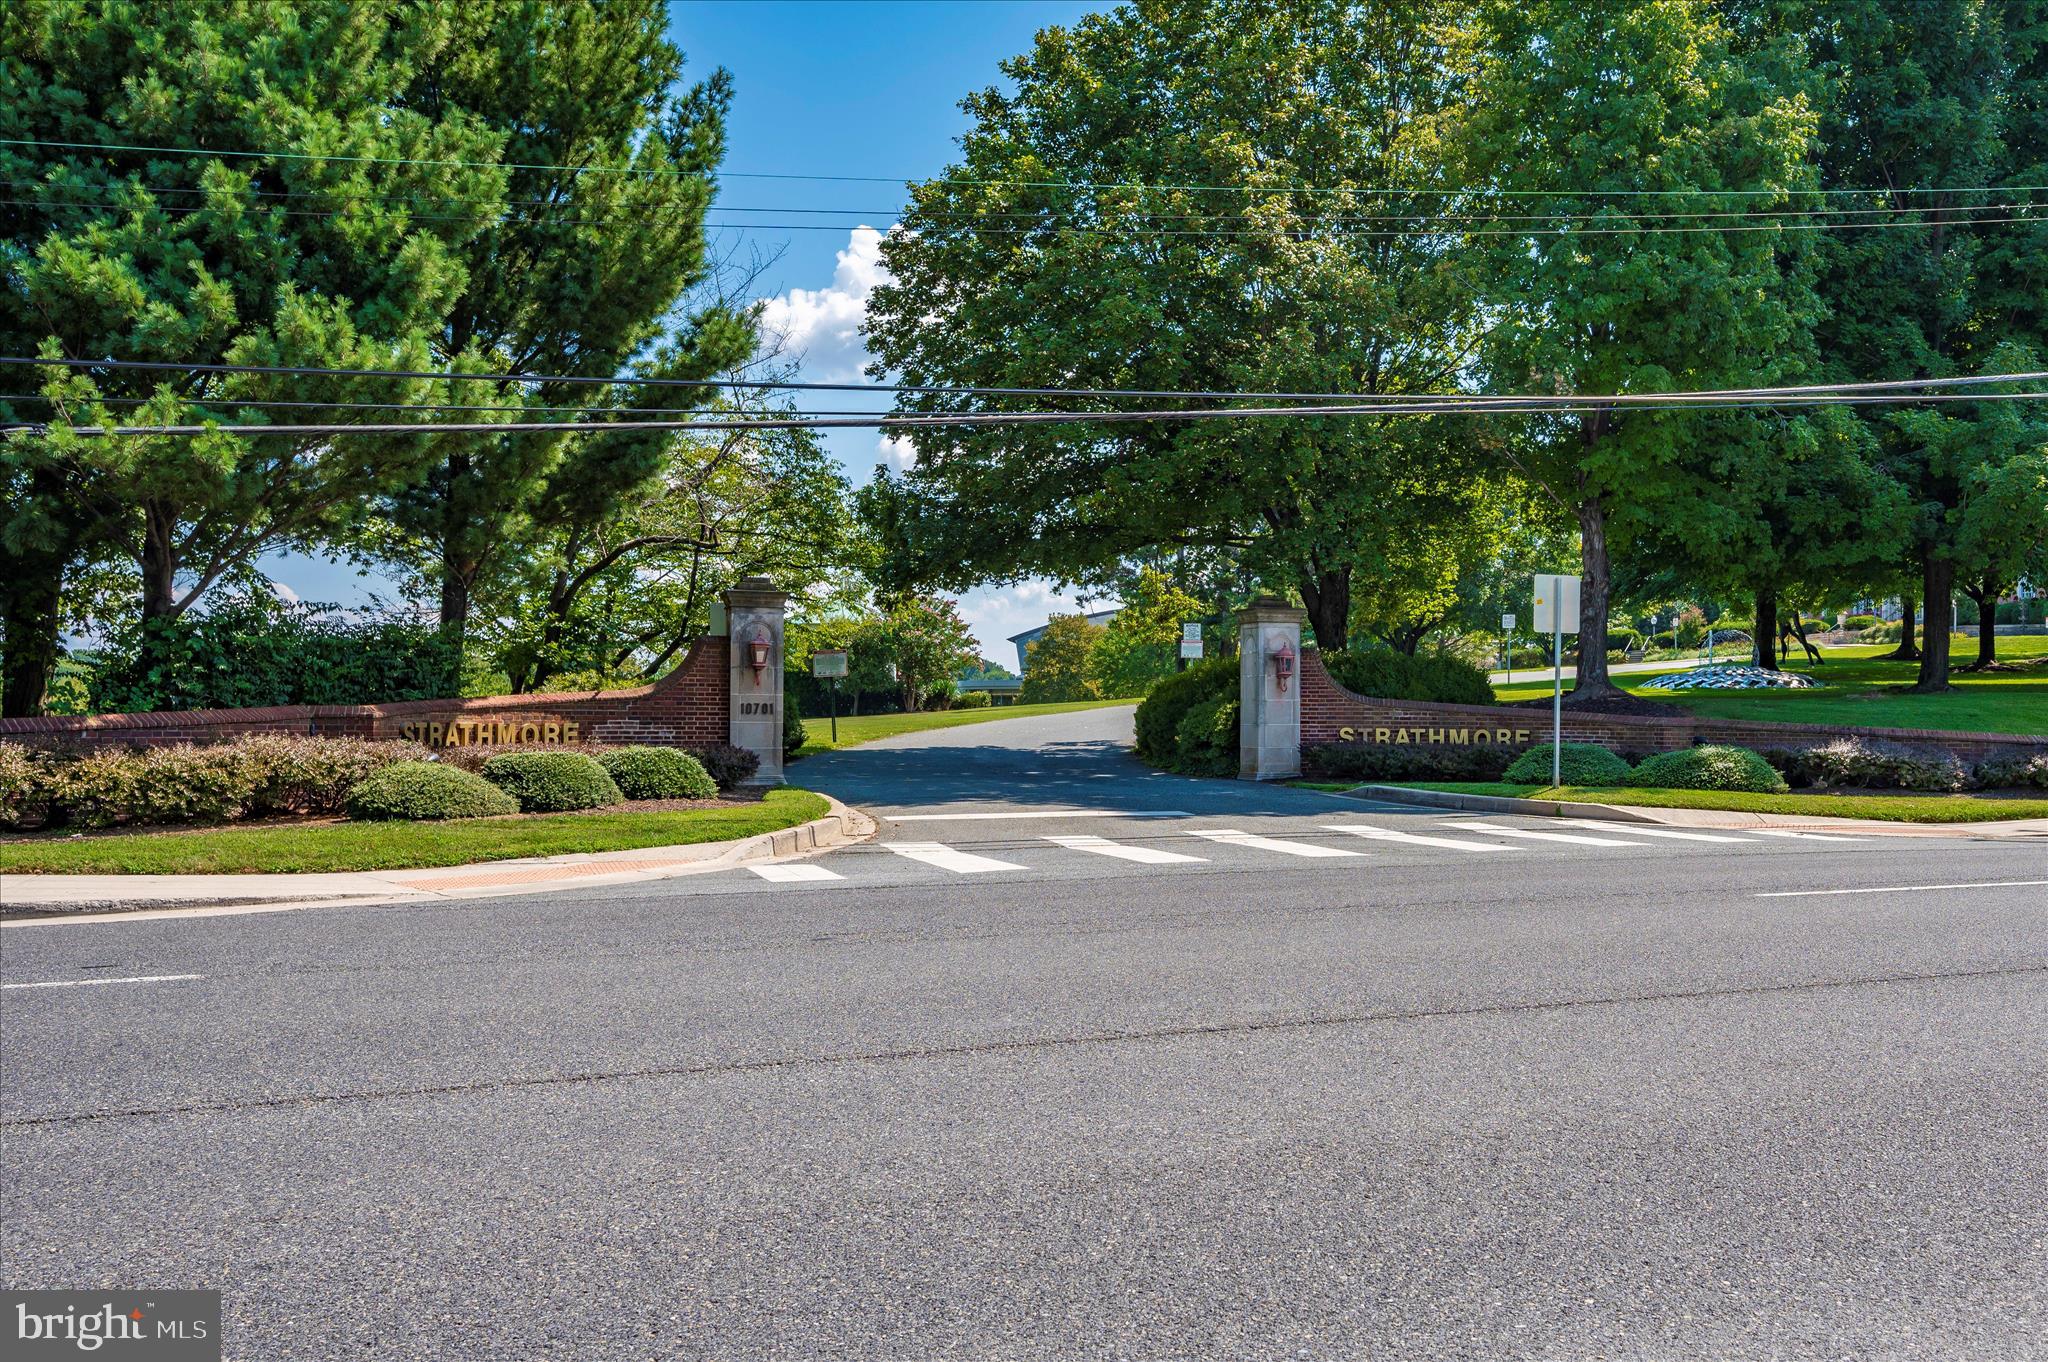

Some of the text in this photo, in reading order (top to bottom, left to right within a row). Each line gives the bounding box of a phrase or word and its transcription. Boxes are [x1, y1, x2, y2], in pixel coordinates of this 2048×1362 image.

[740, 702, 774, 715] 10701
[403, 722, 580, 746] STRATHMORE
[1339, 727, 1530, 745] STRATHMORE
